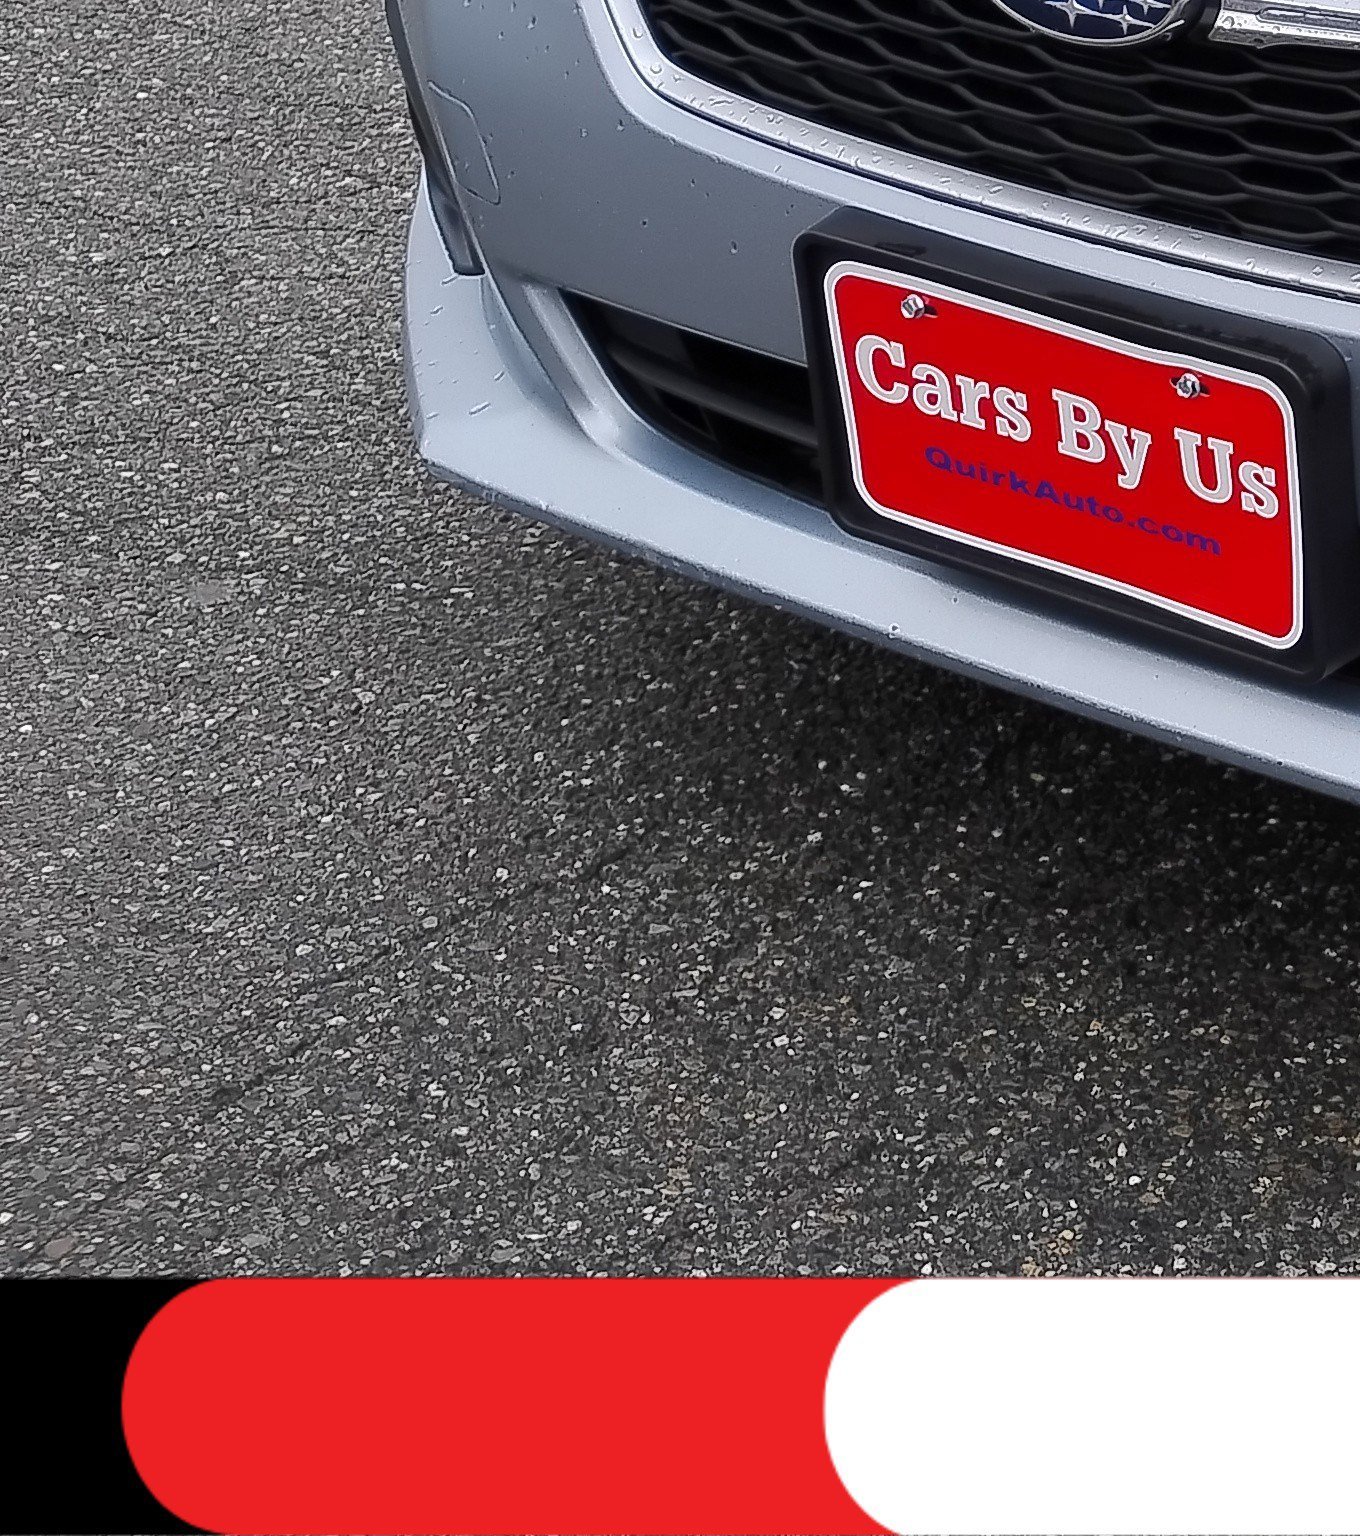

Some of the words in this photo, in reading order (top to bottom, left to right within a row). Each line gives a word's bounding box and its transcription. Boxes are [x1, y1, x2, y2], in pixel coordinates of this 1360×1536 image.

[854, 334, 1032, 442] Cars
[1051, 388, 1153, 490] By
[1173, 427, 1279, 519] Us
[924, 445, 1222, 556] QuirkAuto.com
